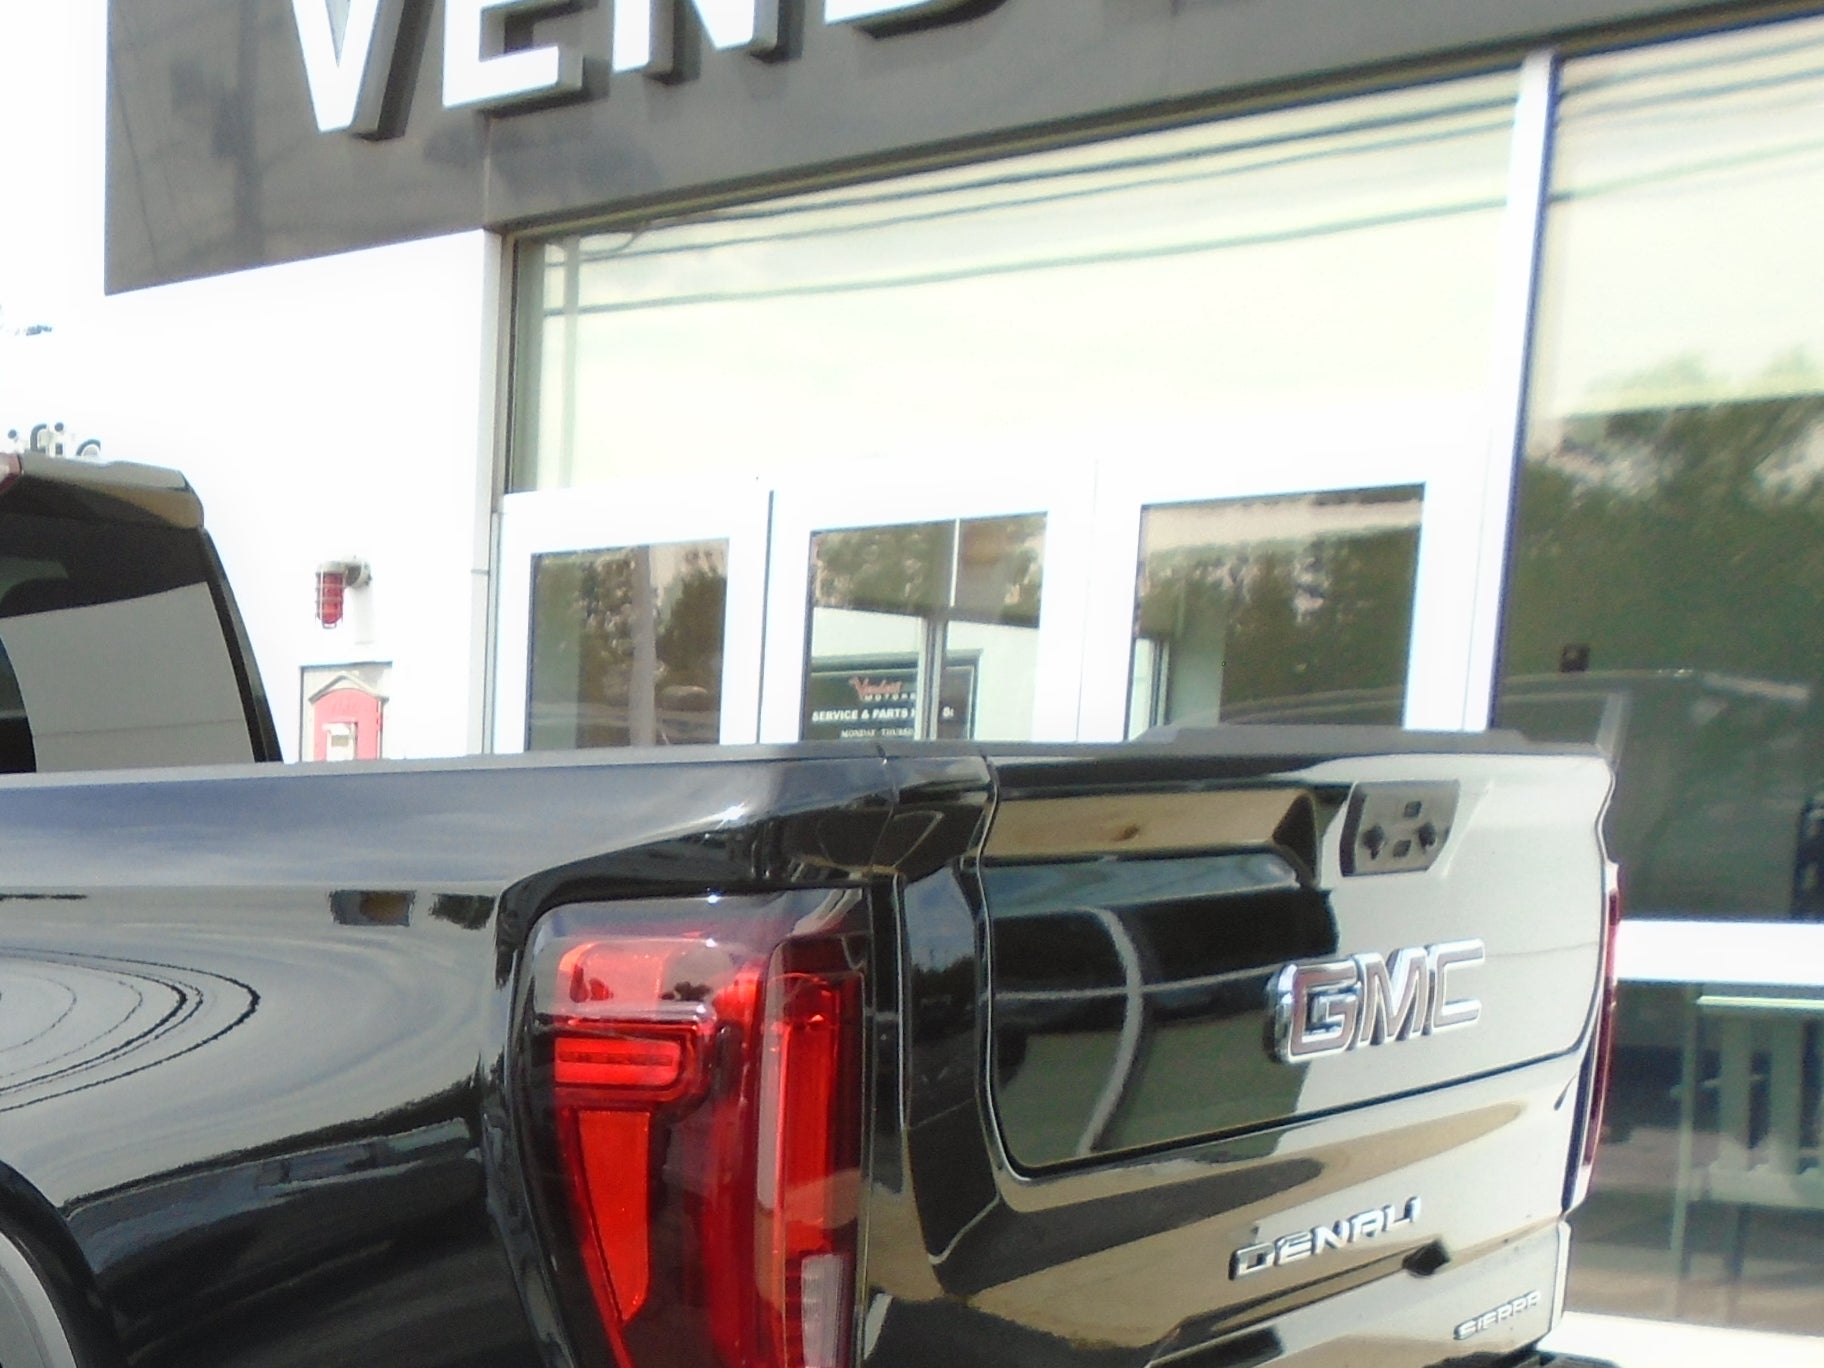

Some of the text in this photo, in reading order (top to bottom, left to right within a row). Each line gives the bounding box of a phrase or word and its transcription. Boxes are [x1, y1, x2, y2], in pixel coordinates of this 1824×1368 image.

[812, 709, 858, 723] SERVICE
[861, 709, 870, 720] &
[872, 707, 908, 719] PARTS
[1266, 938, 1486, 1064] GMC
[1229, 1196, 1422, 1281] DENALI
[1454, 1290, 1542, 1341] SIERRA
